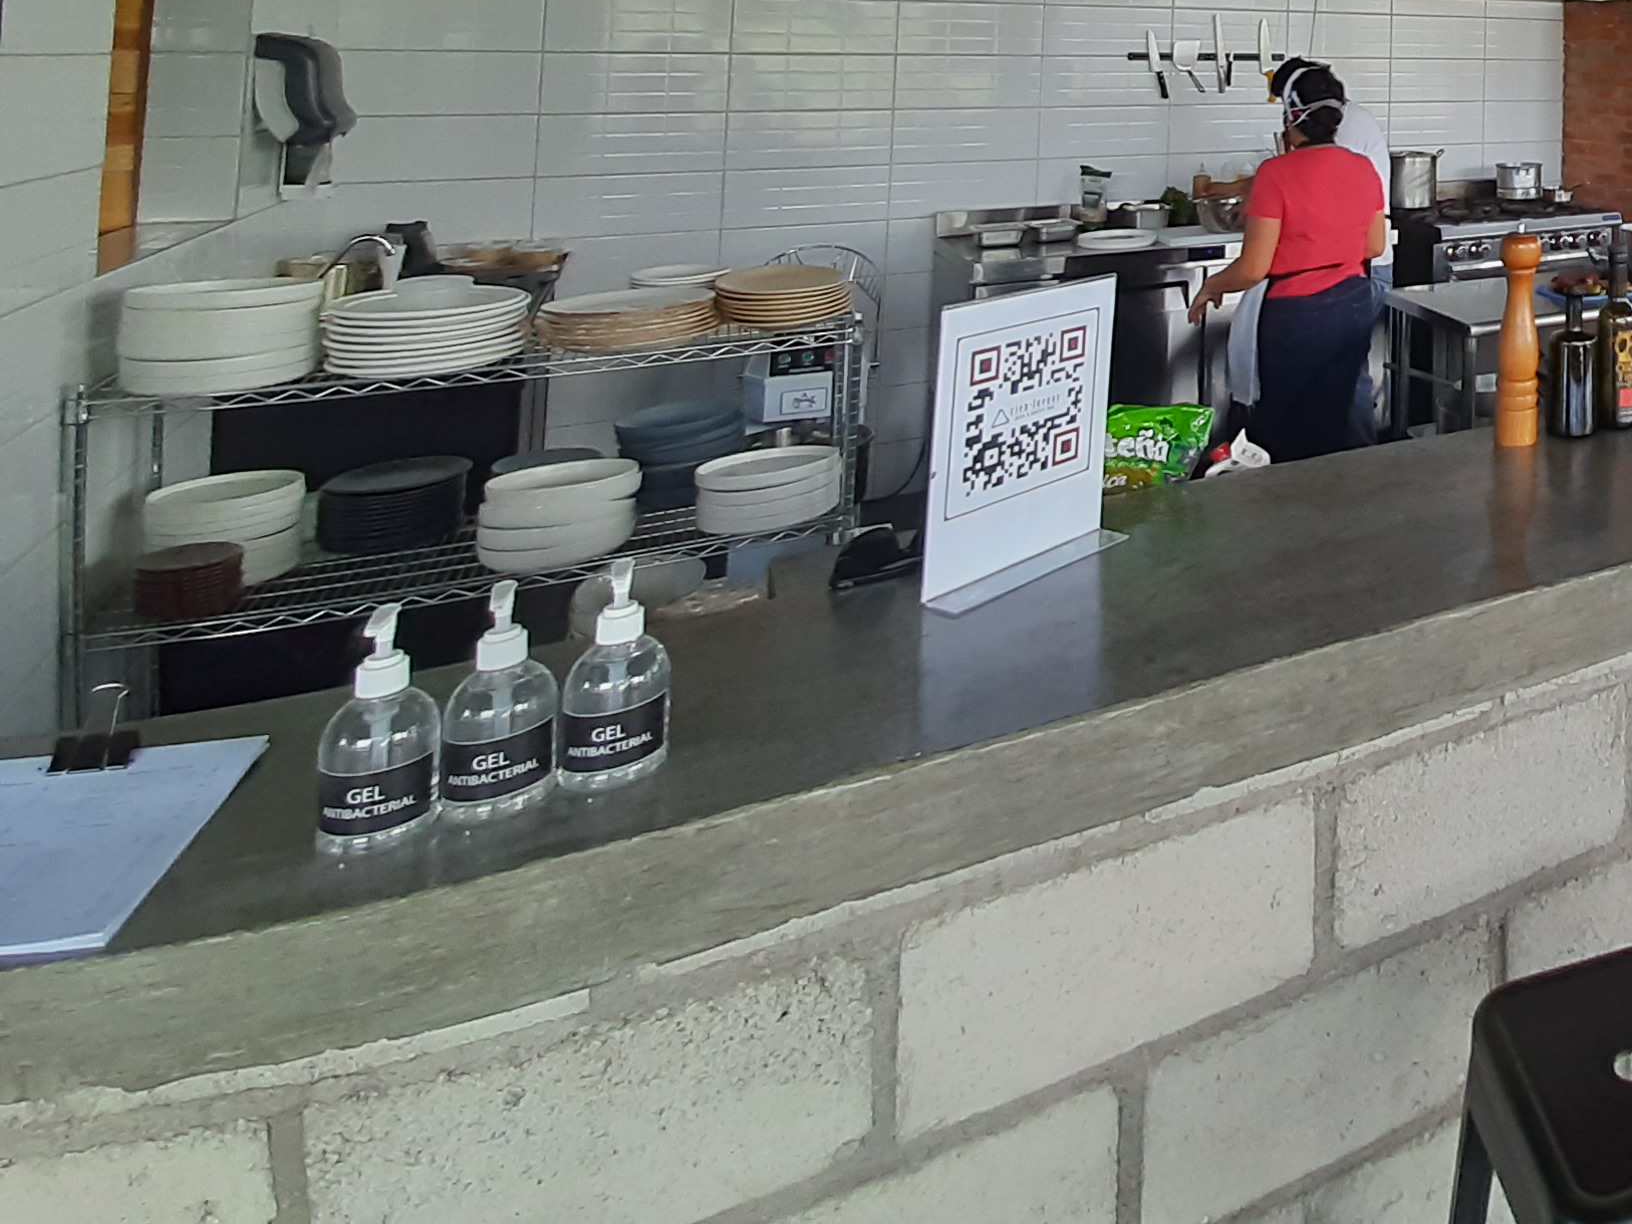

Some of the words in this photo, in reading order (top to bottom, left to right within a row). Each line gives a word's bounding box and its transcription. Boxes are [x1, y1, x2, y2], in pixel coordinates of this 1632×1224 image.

[567, 731, 653, 757] ANTIBACTERIAL
[590, 723, 627, 742] GEL
[447, 757, 540, 786] ANTIBACTERIAL
[472, 751, 511, 771] GEL
[346, 785, 386, 804] GEL
[322, 794, 417, 820] ANTIBACTERIAL
